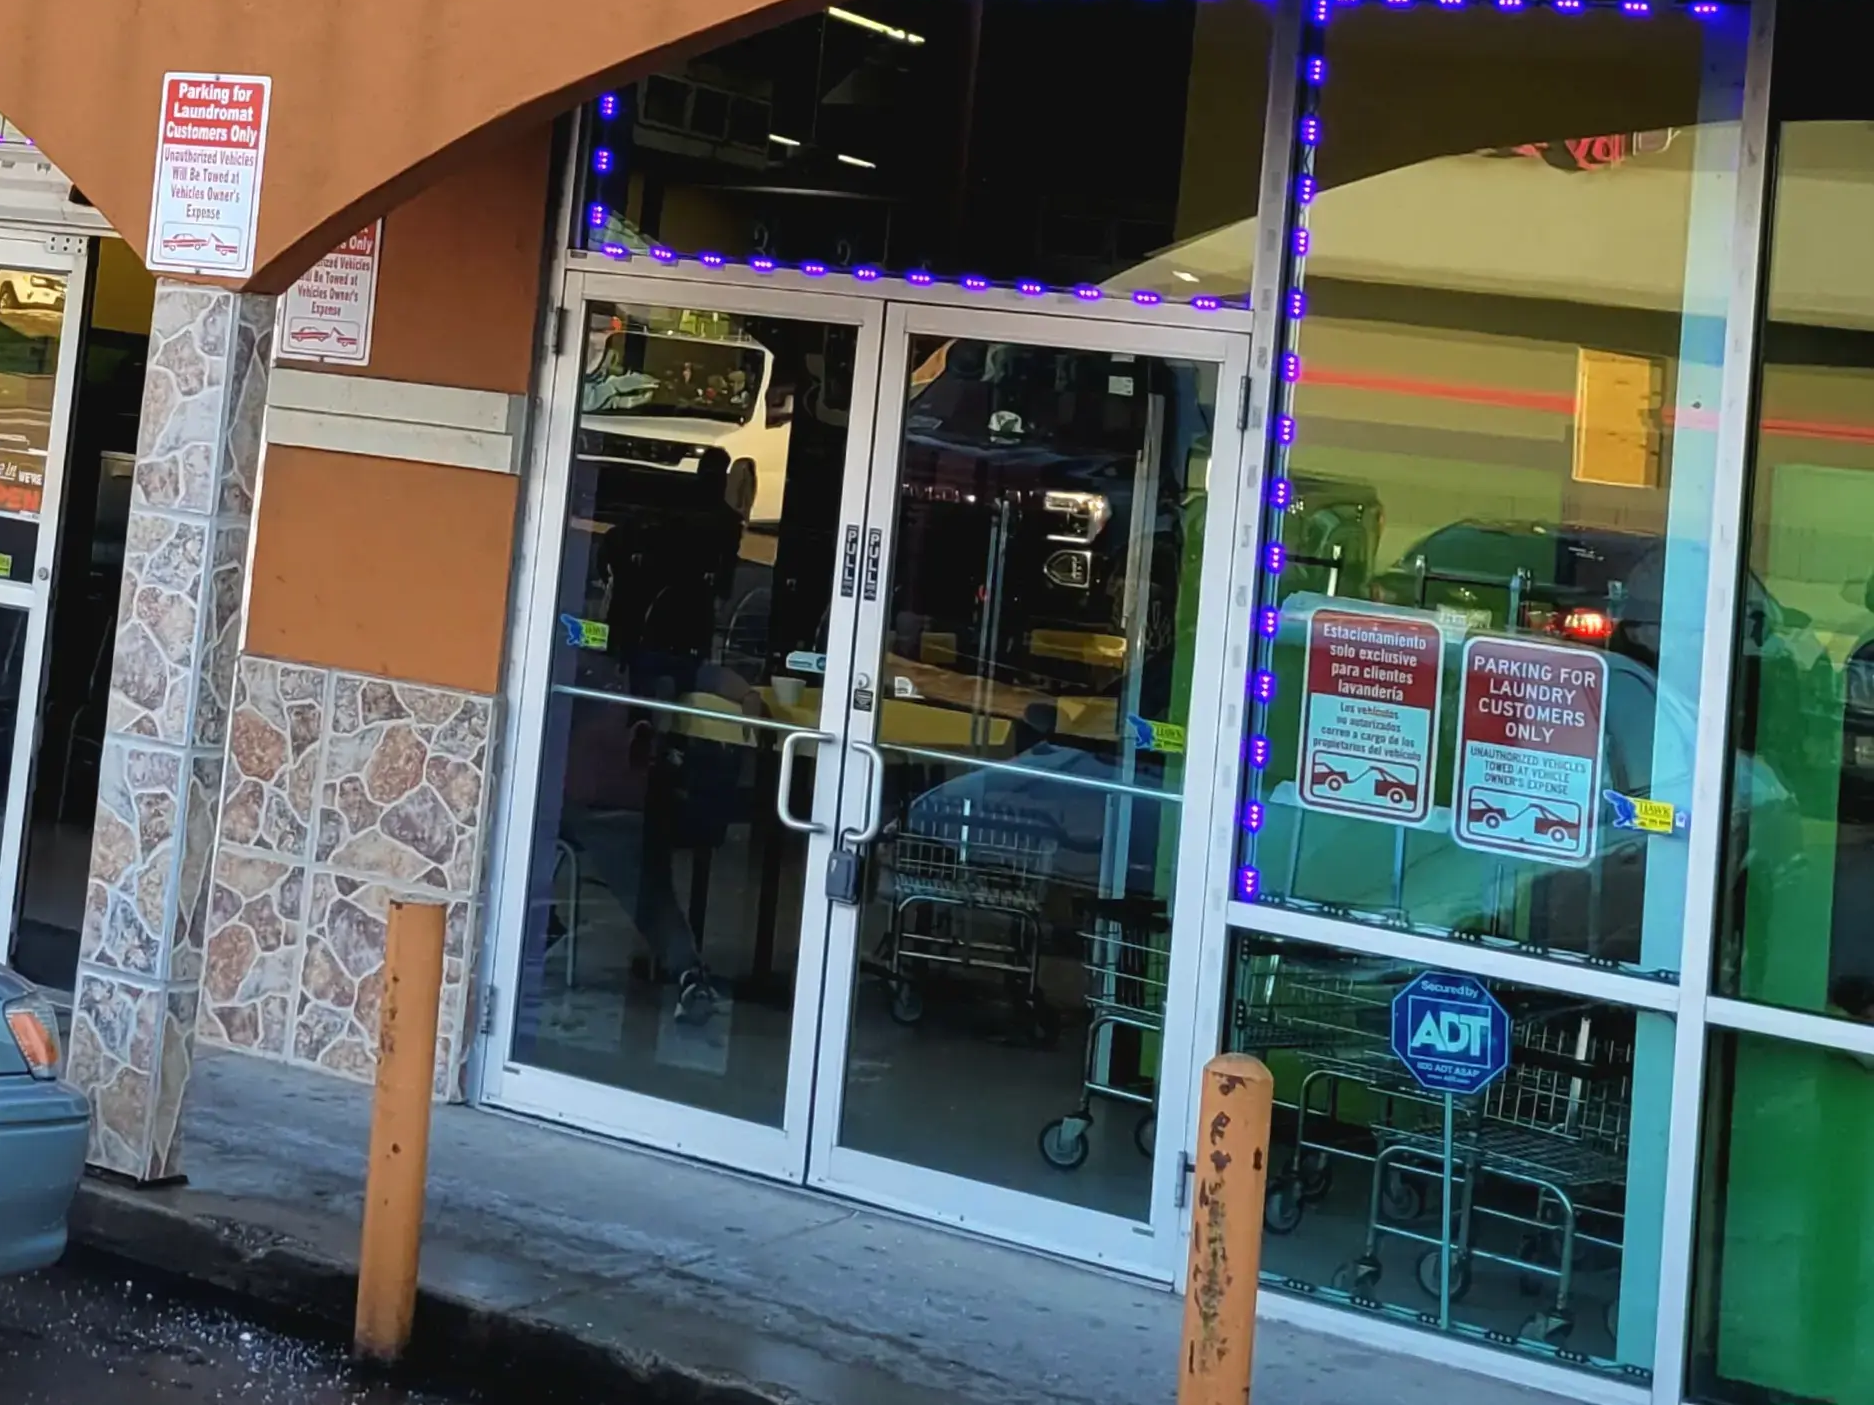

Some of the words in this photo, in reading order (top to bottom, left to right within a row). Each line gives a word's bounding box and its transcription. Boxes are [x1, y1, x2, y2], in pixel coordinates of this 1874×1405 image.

[179, 82, 230, 104] Parking
[232, 85, 253, 102] for
[173, 101, 254, 122] Laundromat
[166, 121, 228, 141] Customers
[230, 125, 257, 147] Only
[220, 150, 254, 167] Vehicles
[189, 167, 200, 182] Be
[203, 168, 229, 183] Towed
[231, 170, 240, 185] at
[171, 184, 204, 200] Vehicles
[207, 186, 240, 203] Owner's
[186, 203, 221, 221] Expense
[349, 235, 373, 254] Only
[843, 530, 858, 580] PULL
[867, 533, 880, 584] PULL
[1323, 623, 1426, 650] Estacionamiento
[1330, 643, 1355, 658] solo
[1359, 647, 1418, 668] exclusive
[1331, 662, 1360, 678] para
[1363, 665, 1413, 685] clientes
[1474, 656, 1552, 682] PARKING
[1560, 667, 1596, 689] FOR
[1489, 678, 1576, 706] LAUNDRY
[1478, 697, 1586, 728] CUSTOMERS
[1505, 722, 1555, 744] ONLY
[1470, 745, 1538, 765] UNAUTHORIZED
[1542, 756, 1586, 774] VEHICLES
[1484, 760, 1514, 774] TOWED
[1527, 778, 1568, 795] EXPENSE
[1421, 980, 1464, 996] Secured
[1464, 984, 1479, 999] by
[1411, 1009, 1490, 1057] ADT
